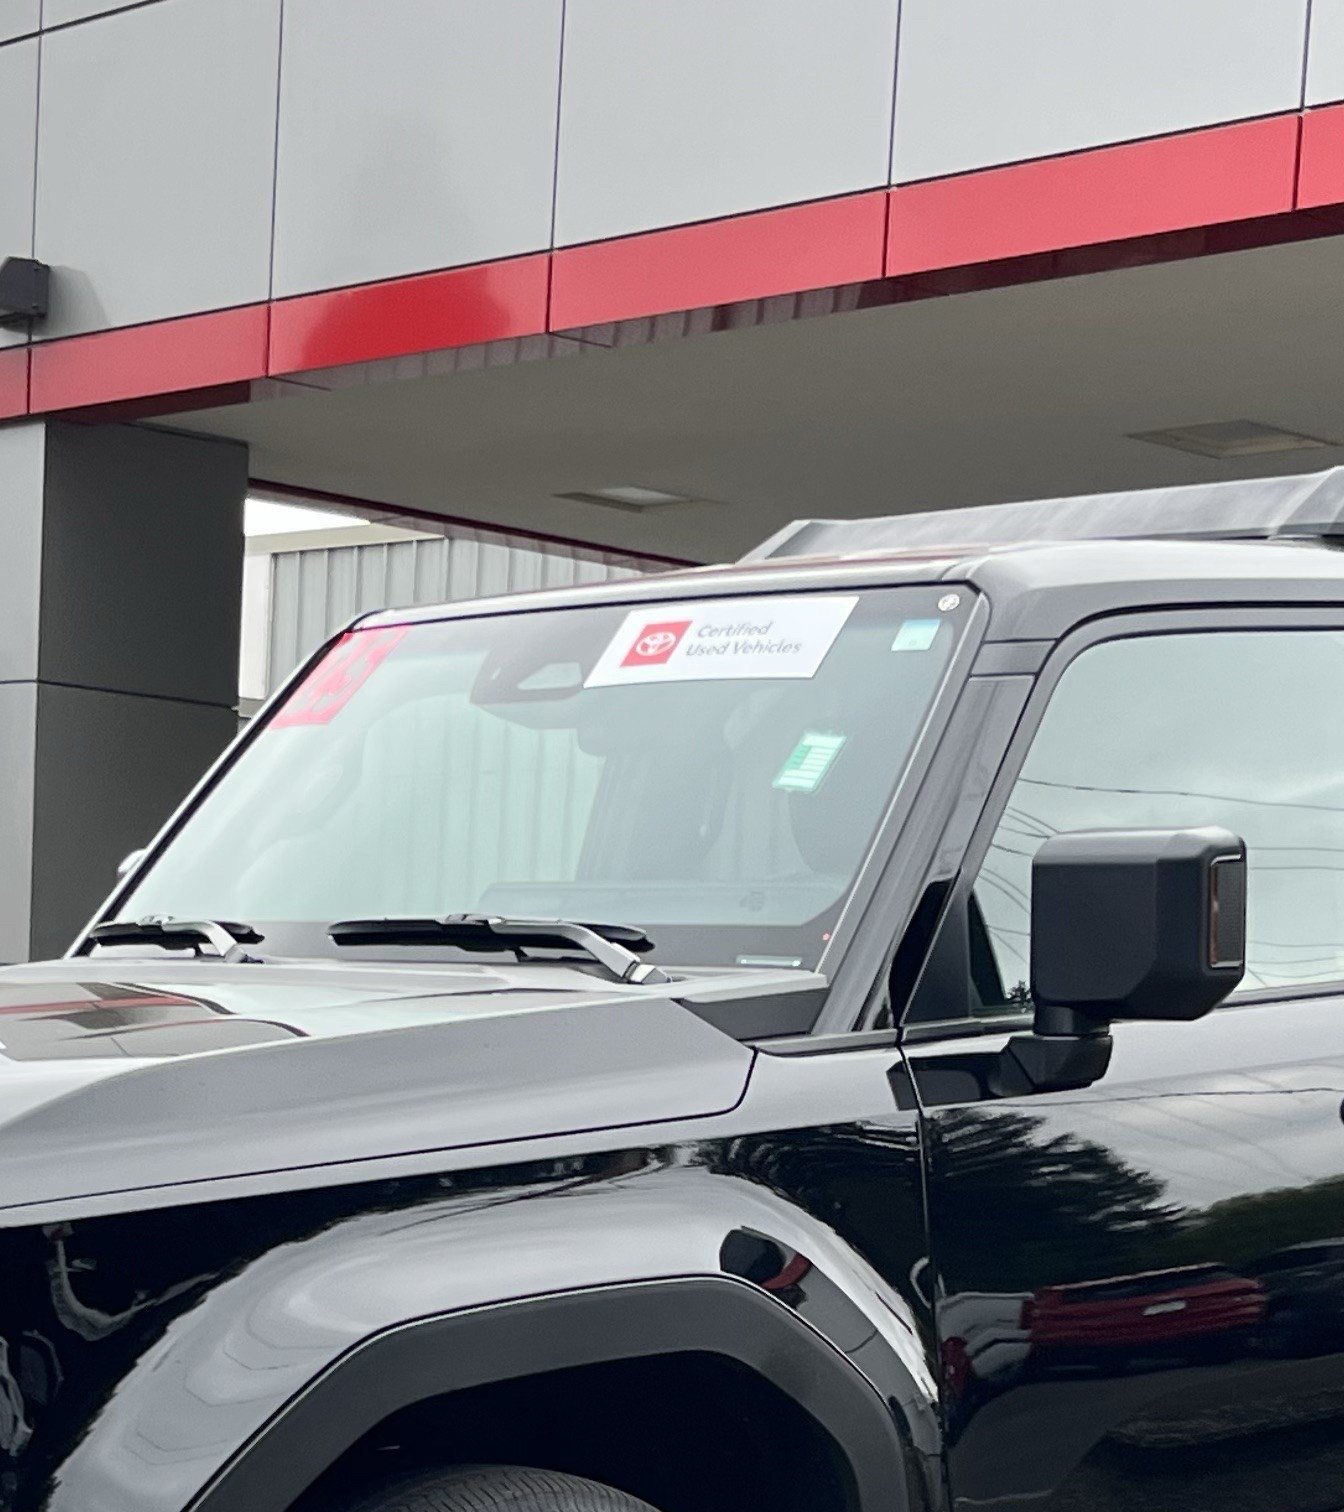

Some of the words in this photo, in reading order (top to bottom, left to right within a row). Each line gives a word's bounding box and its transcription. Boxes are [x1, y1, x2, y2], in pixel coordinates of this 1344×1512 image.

[696, 620, 774, 639] Certified
[685, 642, 729, 657] Used
[732, 639, 803, 657] Vehicles
